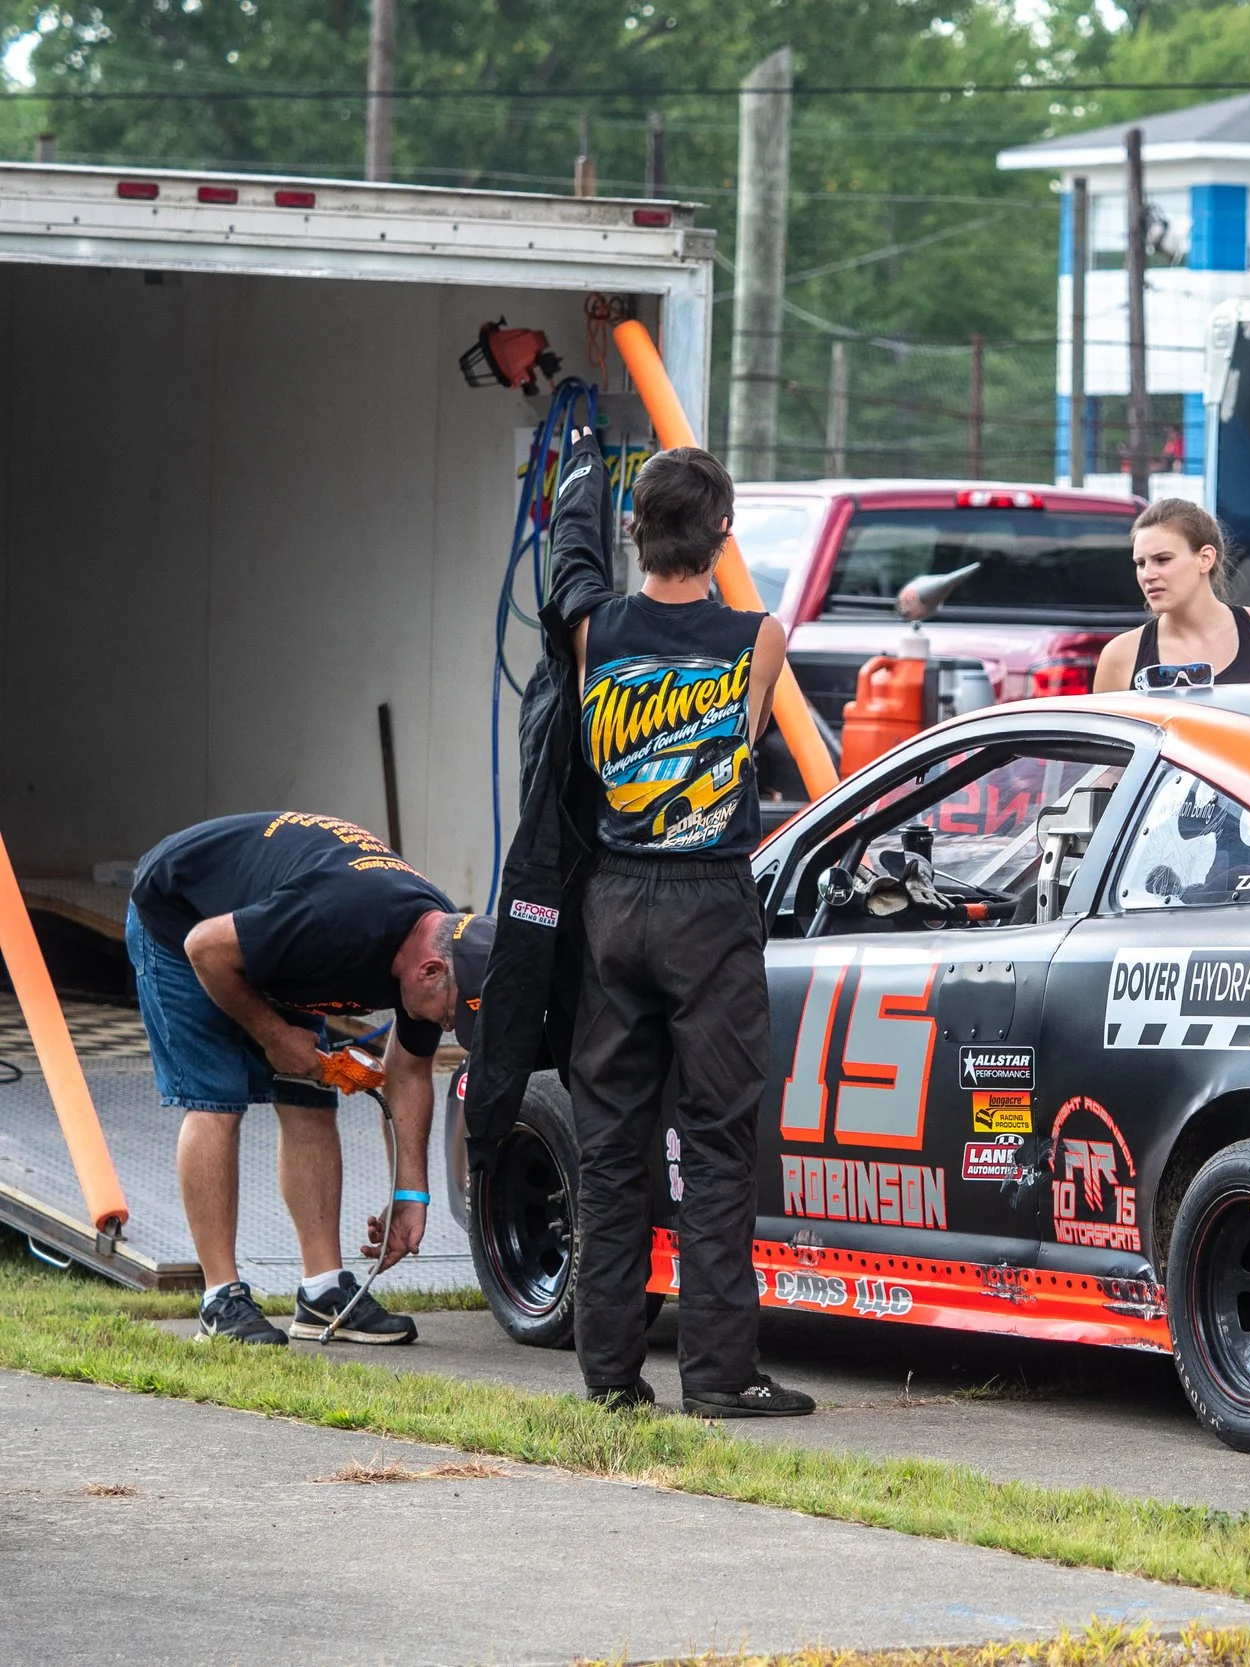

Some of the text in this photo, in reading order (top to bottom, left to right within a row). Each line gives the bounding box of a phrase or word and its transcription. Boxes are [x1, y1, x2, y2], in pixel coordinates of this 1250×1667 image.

[582, 652, 750, 773] Midwest
[602, 702, 741, 779] Compact Touring Series
[667, 807, 703, 840] 2016
[513, 911, 555, 926] RACING GEAR
[1113, 962, 1180, 1001] DOVER
[780, 946, 943, 1151] 15
[975, 1055, 1030, 1066] ALLSTAR
[976, 1070, 1030, 1079] PERFORMANCE
[1084, 1096, 1136, 1177] ROBINSON
[967, 1166, 1018, 1175] AUTOMOTIVE
[780, 1154, 947, 1230] ROBINSON
[1052, 1180, 1076, 1219] 10
[1114, 1186, 1136, 1225] 15
[1054, 1218, 1141, 1252] MOTORSPORTS
[775, 1272, 847, 1306] CARS
[853, 1277, 913, 1317] LLC
